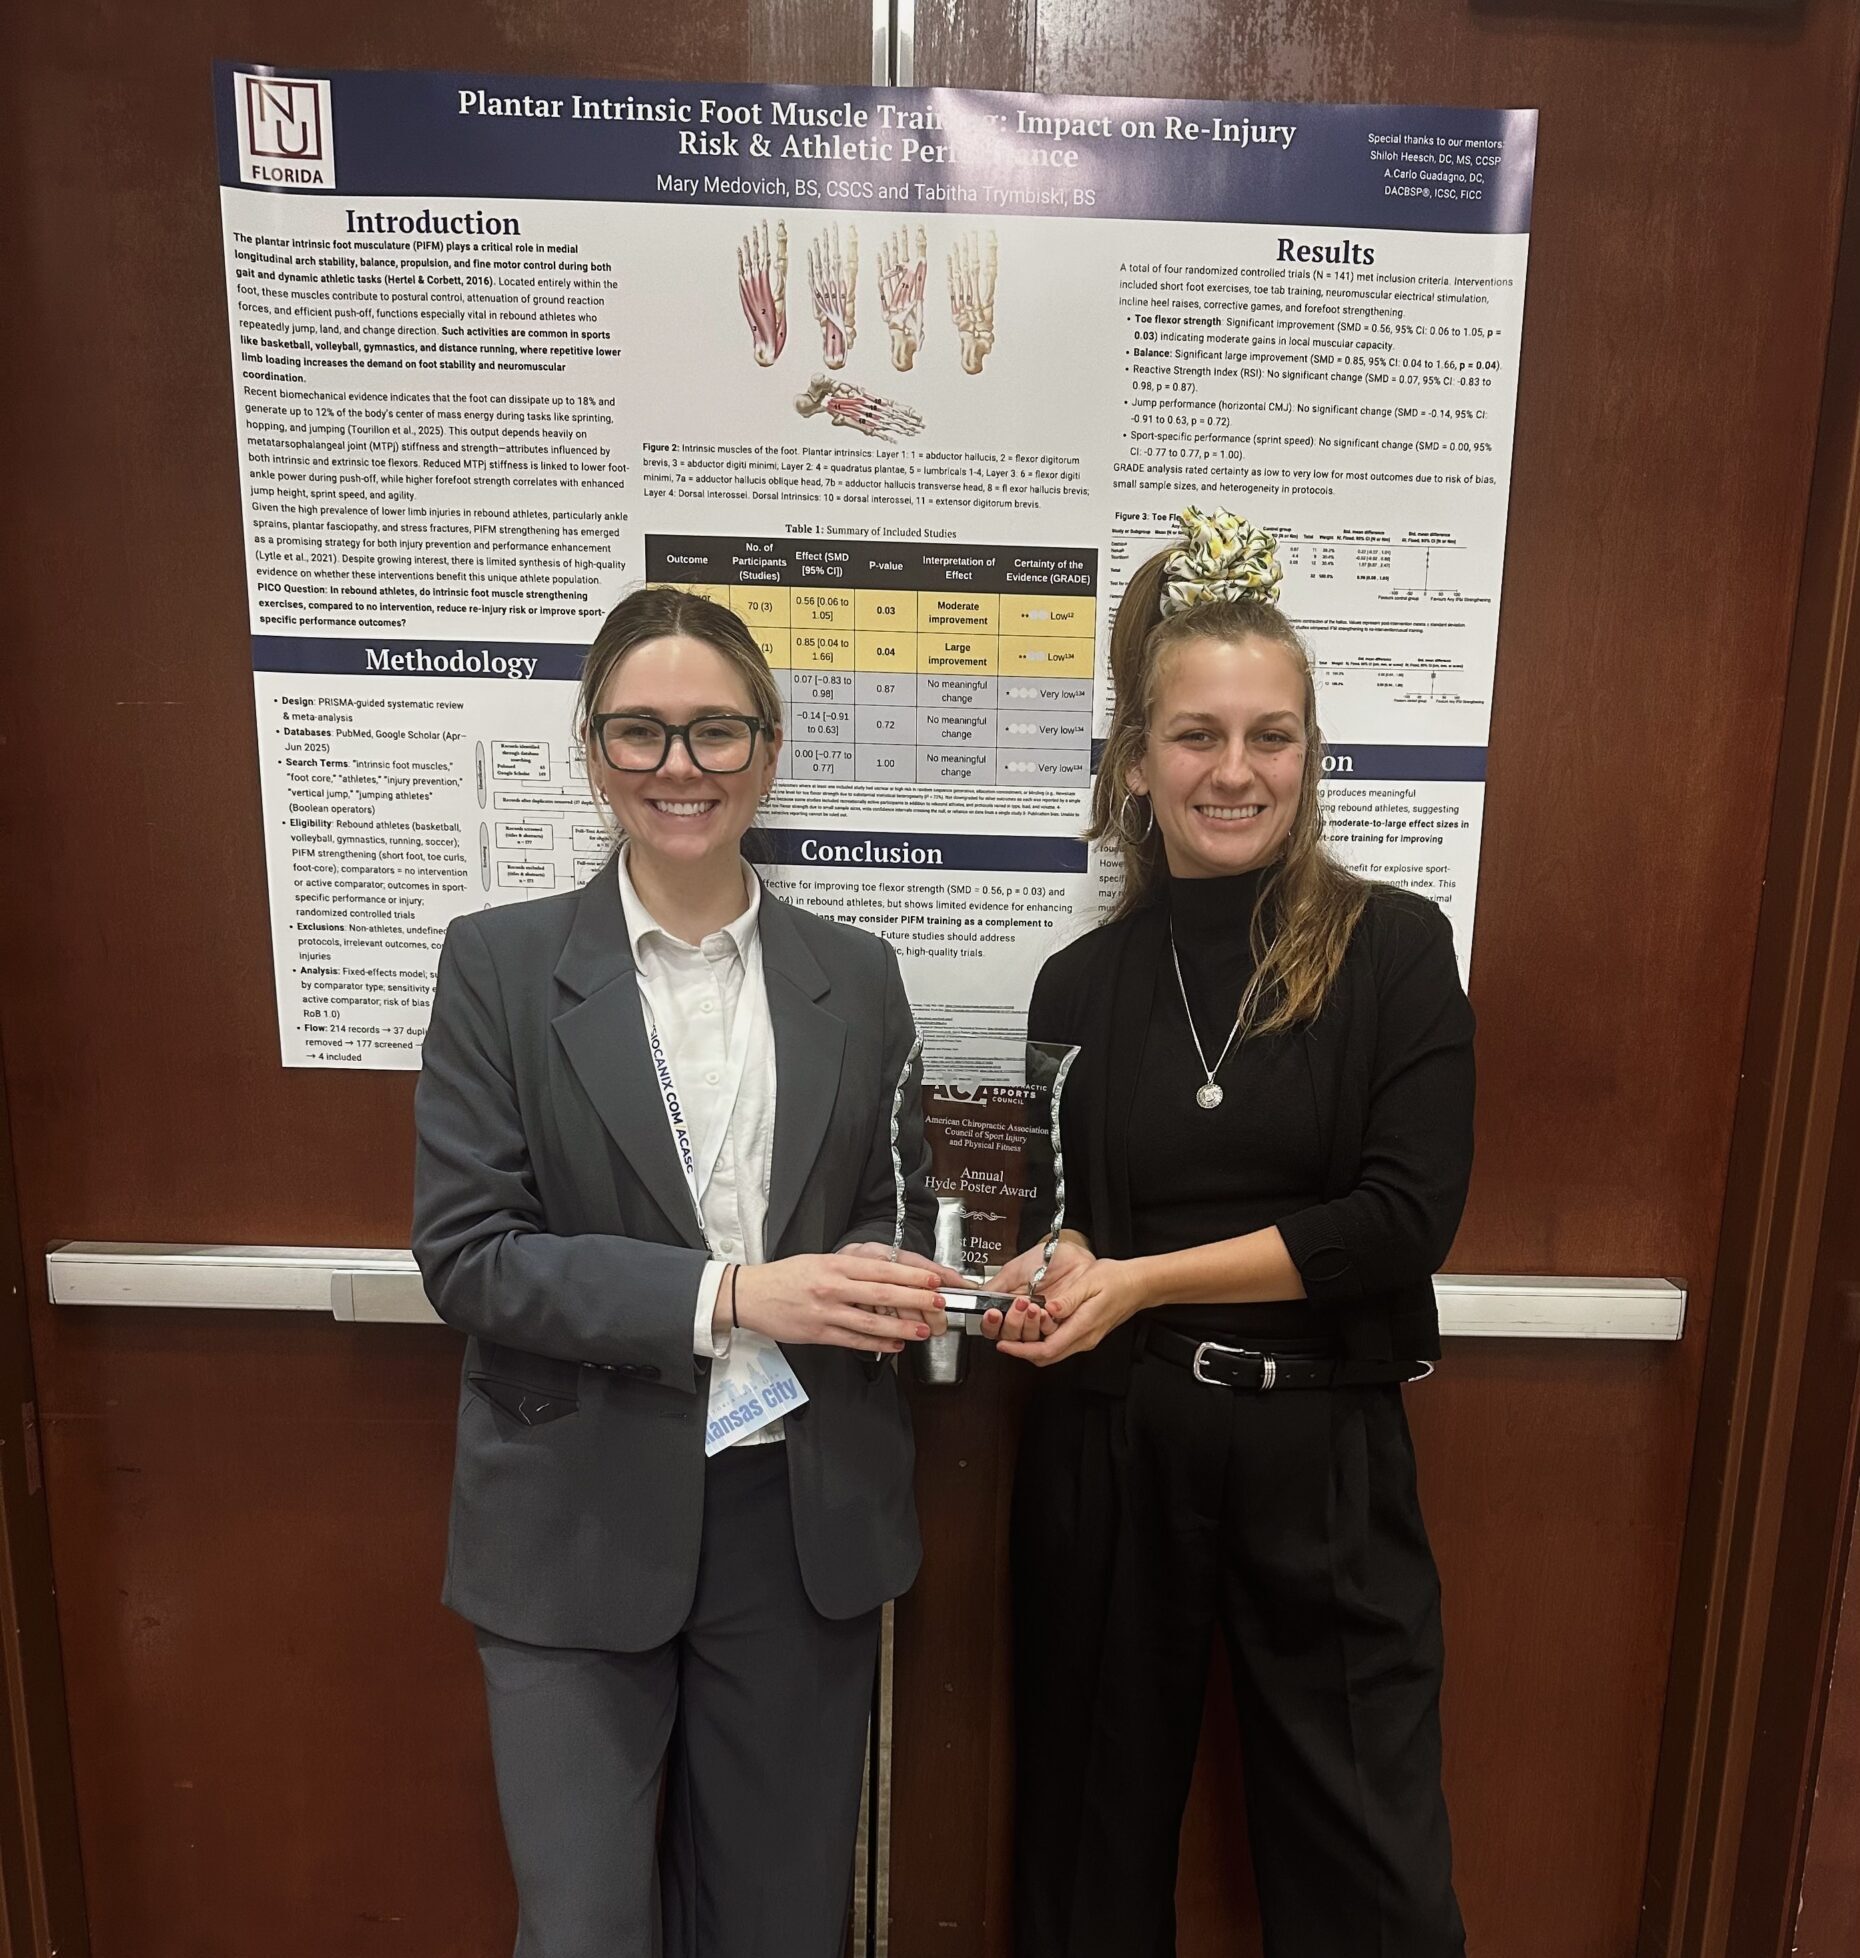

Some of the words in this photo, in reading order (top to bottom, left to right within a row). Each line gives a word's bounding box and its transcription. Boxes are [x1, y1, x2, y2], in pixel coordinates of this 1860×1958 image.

[458, 90, 563, 118] Plantar
[571, 95, 692, 123] Intrinsic
[699, 100, 762, 125] Foot
[770, 101, 868, 129] Muscle
[1016, 110, 1112, 141] Impact
[1121, 121, 1156, 139] on
[1164, 116, 1297, 150] Re-Injury
[679, 131, 739, 156] Risk
[749, 133, 771, 158] &
[781, 134, 893, 163] Athletic
[1368, 133, 1401, 144] Special
[1404, 135, 1434, 146] thanks
[1436, 137, 1446, 146] to
[1448, 139, 1463, 147] our
[1465, 138, 1505, 149] mentors:
[1370, 151, 1398, 161] Shiloh
[1401, 153, 1436, 164] Heesch,
[1439, 154, 1454, 165] DC,
[1457, 155, 1473, 166] MS,
[1475, 156, 1501, 166] CCSP
[252, 165, 324, 184] FLORIDA
[1419, 170, 1467, 184] Guadagno,
[1469, 173, 1485, 184] DC,
[657, 174, 699, 196] Mary
[704, 176, 790, 198] Medovich,
[795, 179, 822, 198] BS,
[826, 181, 873, 200] CSCS
[878, 182, 908, 201] and
[914, 183, 977, 202] Tabitha
[982, 185, 1068, 208] Trymbiski,
[1073, 188, 1096, 206] BS
[1435, 188, 1458, 200] ICSC,
[1460, 189, 1482, 200] FICC
[346, 209, 521, 236] Introduction
[1276, 238, 1375, 266] Results
[1119, 297, 1148, 306] incline
[1151, 298, 1169, 306] heel
[1172, 300, 1201, 310] raises,
[1204, 301, 1249, 310] corrective
[1251, 304, 1283, 313] games,
[1286, 303, 1302, 312] and
[1304, 303, 1340, 313] forefoot
[240, 335, 258, 345] like
[261, 337, 313, 351] basketball,
[315, 340, 361, 353] volleyball,
[363, 342, 418, 354] gymnastics,
[420, 343, 436, 352] and
[439, 343, 478, 353] distance
[480, 345, 518, 356] running,
[520, 346, 548, 355] where
[550, 346, 593, 357] repetitive
[596, 347, 621, 357] lower
[785, 524, 812, 534] Table
[814, 525, 824, 534] 1:
[827, 526, 869, 538] Summary
[871, 527, 880, 536] of
[883, 527, 922, 538] Included
[924, 528, 957, 539] Studies
[746, 543, 762, 552] No.
[763, 543, 774, 552] of
[666, 554, 709, 565] Outcome
[732, 556, 787, 568] Participants
[795, 551, 822, 561] Effect
[824, 552, 850, 563] (SMD
[922, 555, 984, 567] Interpretation
[986, 557, 996, 567] of
[869, 561, 904, 571] P-value
[1014, 559, 1056, 571] Certainty
[1058, 559, 1068, 569] of
[1070, 560, 1084, 570] the
[739, 571, 781, 583] (Studies)
[802, 566, 825, 577] [95%
[827, 567, 843, 578] CI])
[946, 570, 973, 580] Effect
[1006, 573, 1048, 583] Evidence
[1050, 574, 1091, 586] (GRADE)
[748, 602, 759, 611] 70
[761, 602, 773, 612] (3)
[796, 596, 815, 606] 0.56
[817, 597, 838, 607] [0.06
[840, 598, 849, 607] to
[937, 601, 980, 612] Moderate
[812, 611, 834, 622] 1.05]
[876, 606, 896, 616] 0.03
[928, 614, 988, 626] improvement
[796, 637, 815, 647] 0.85
[817, 638, 838, 648] [0.04
[840, 639, 849, 648] to
[944, 642, 971, 654] Large
[812, 652, 834, 663] 1.66]
[876, 647, 896, 657] 0.04
[366, 648, 538, 679] Methodology
[928, 656, 988, 667] improvement
[876, 684, 895, 694] 0.87
[927, 679, 940, 689] No
[941, 680, 988, 691] meaningful
[282, 697, 315, 708] Design:
[318, 698, 385, 709] PRISMA-guided
[387, 700, 434, 710] systematic
[436, 701, 464, 710] review
[941, 694, 973, 705] change
[283, 712, 290, 721] &
[292, 713, 353, 723] meta-analysis
[876, 720, 895, 730] 0.72
[284, 728, 334, 738] Databases:
[336, 729, 374, 739] PubMed,
[375, 730, 406, 741] Google
[408, 730, 440, 740] Scholar
[285, 743, 302, 752] Jun
[304, 743, 330, 754] 2025)
[1328, 788, 1367, 799] produces
[1369, 788, 1416, 800] meaningful
[1338, 803, 1373, 813] rebound
[1375, 804, 1411, 815] athletes,
[1413, 805, 1460, 817] suggesting
[801, 839, 944, 865] Conclusion
[881, 930, 910, 941] Future
[912, 931, 945, 941] studies
[947, 932, 978, 942] should
[979, 933, 1016, 943] address
[993, 1087, 1036, 1099] SPORTS
[992, 1096, 1025, 1105] COUNCIL
[925, 1115, 960, 1127] American
[962, 1118, 1006, 1131] Chiropractic
[1007, 1123, 1049, 1135] Association
[945, 1127, 974, 1138] Council
[975, 1131, 984, 1139] of
[985, 1131, 1004, 1142] Sport
[1006, 1133, 1028, 1145] Injury
[949, 1139, 963, 1147] and
[964, 1140, 995, 1152] Physical
[996, 1142, 1022, 1153] Fitness
[961, 1167, 1004, 1183] Annual
[925, 1176, 957, 1193] Hyde
[960, 1178, 997, 1195] Poster
[1000, 1182, 1038, 1199] Award
[970, 1236, 1002, 1251] Place
[961, 1250, 989, 1264] 2025
